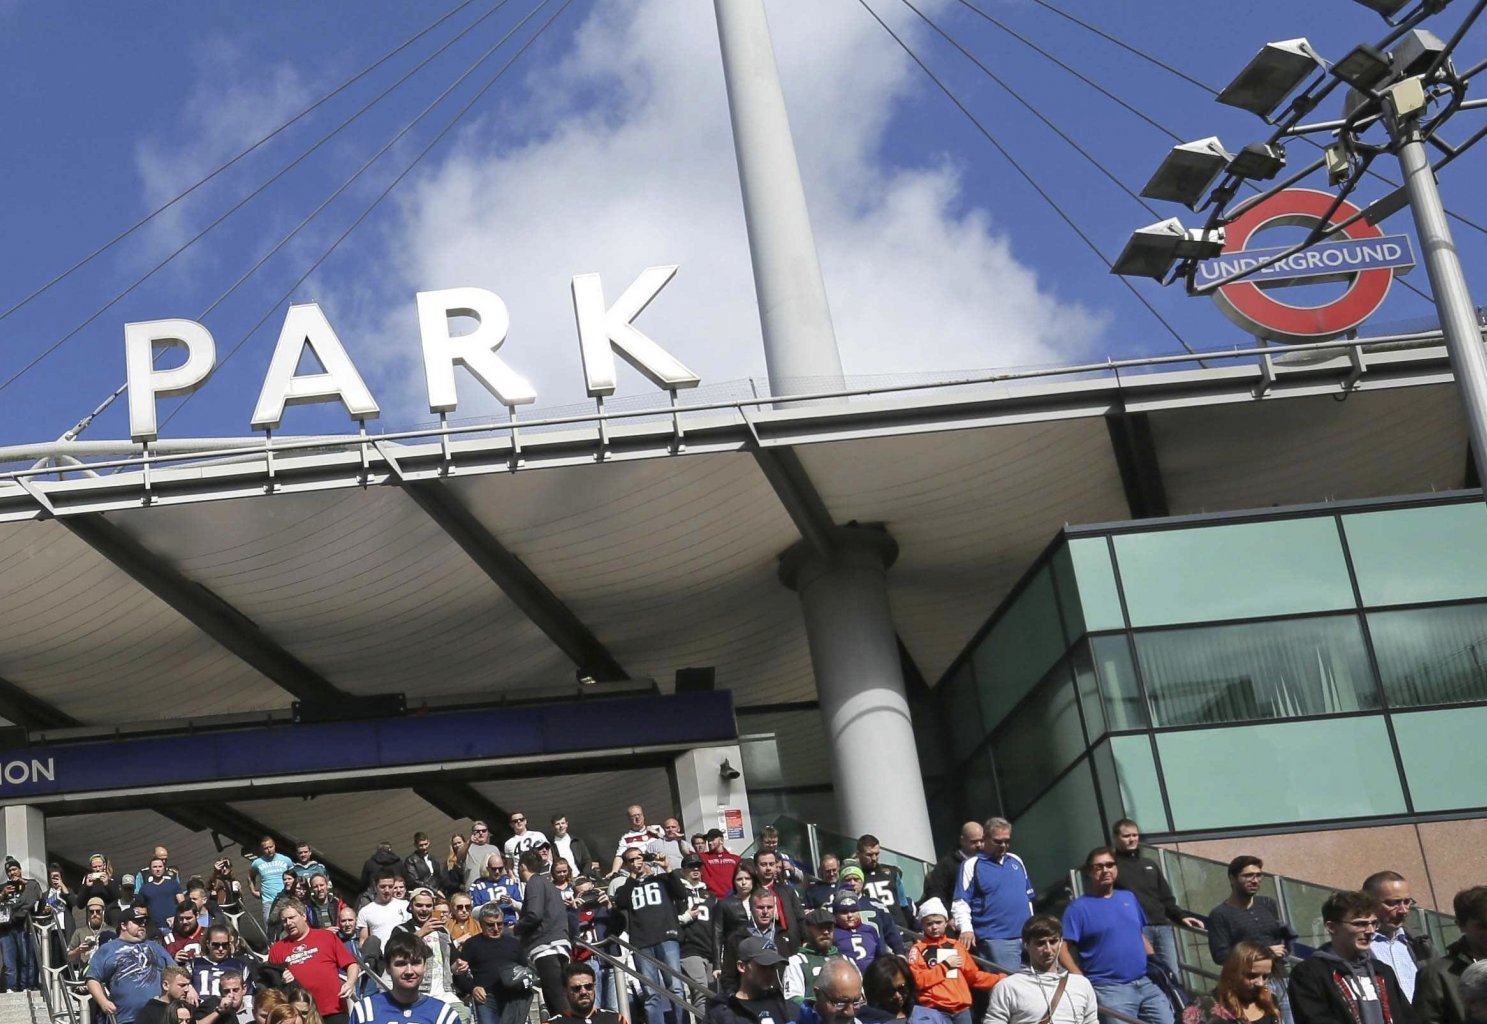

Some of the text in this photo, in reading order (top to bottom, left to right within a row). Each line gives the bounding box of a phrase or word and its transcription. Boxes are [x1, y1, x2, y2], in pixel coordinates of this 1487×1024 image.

[1199, 243, 1402, 281] UNDERGROUND
[124, 264, 701, 442] PARK
[632, 882, 662, 910] 86
[864, 881, 894, 906] 15
[851, 937, 866, 960] 5
